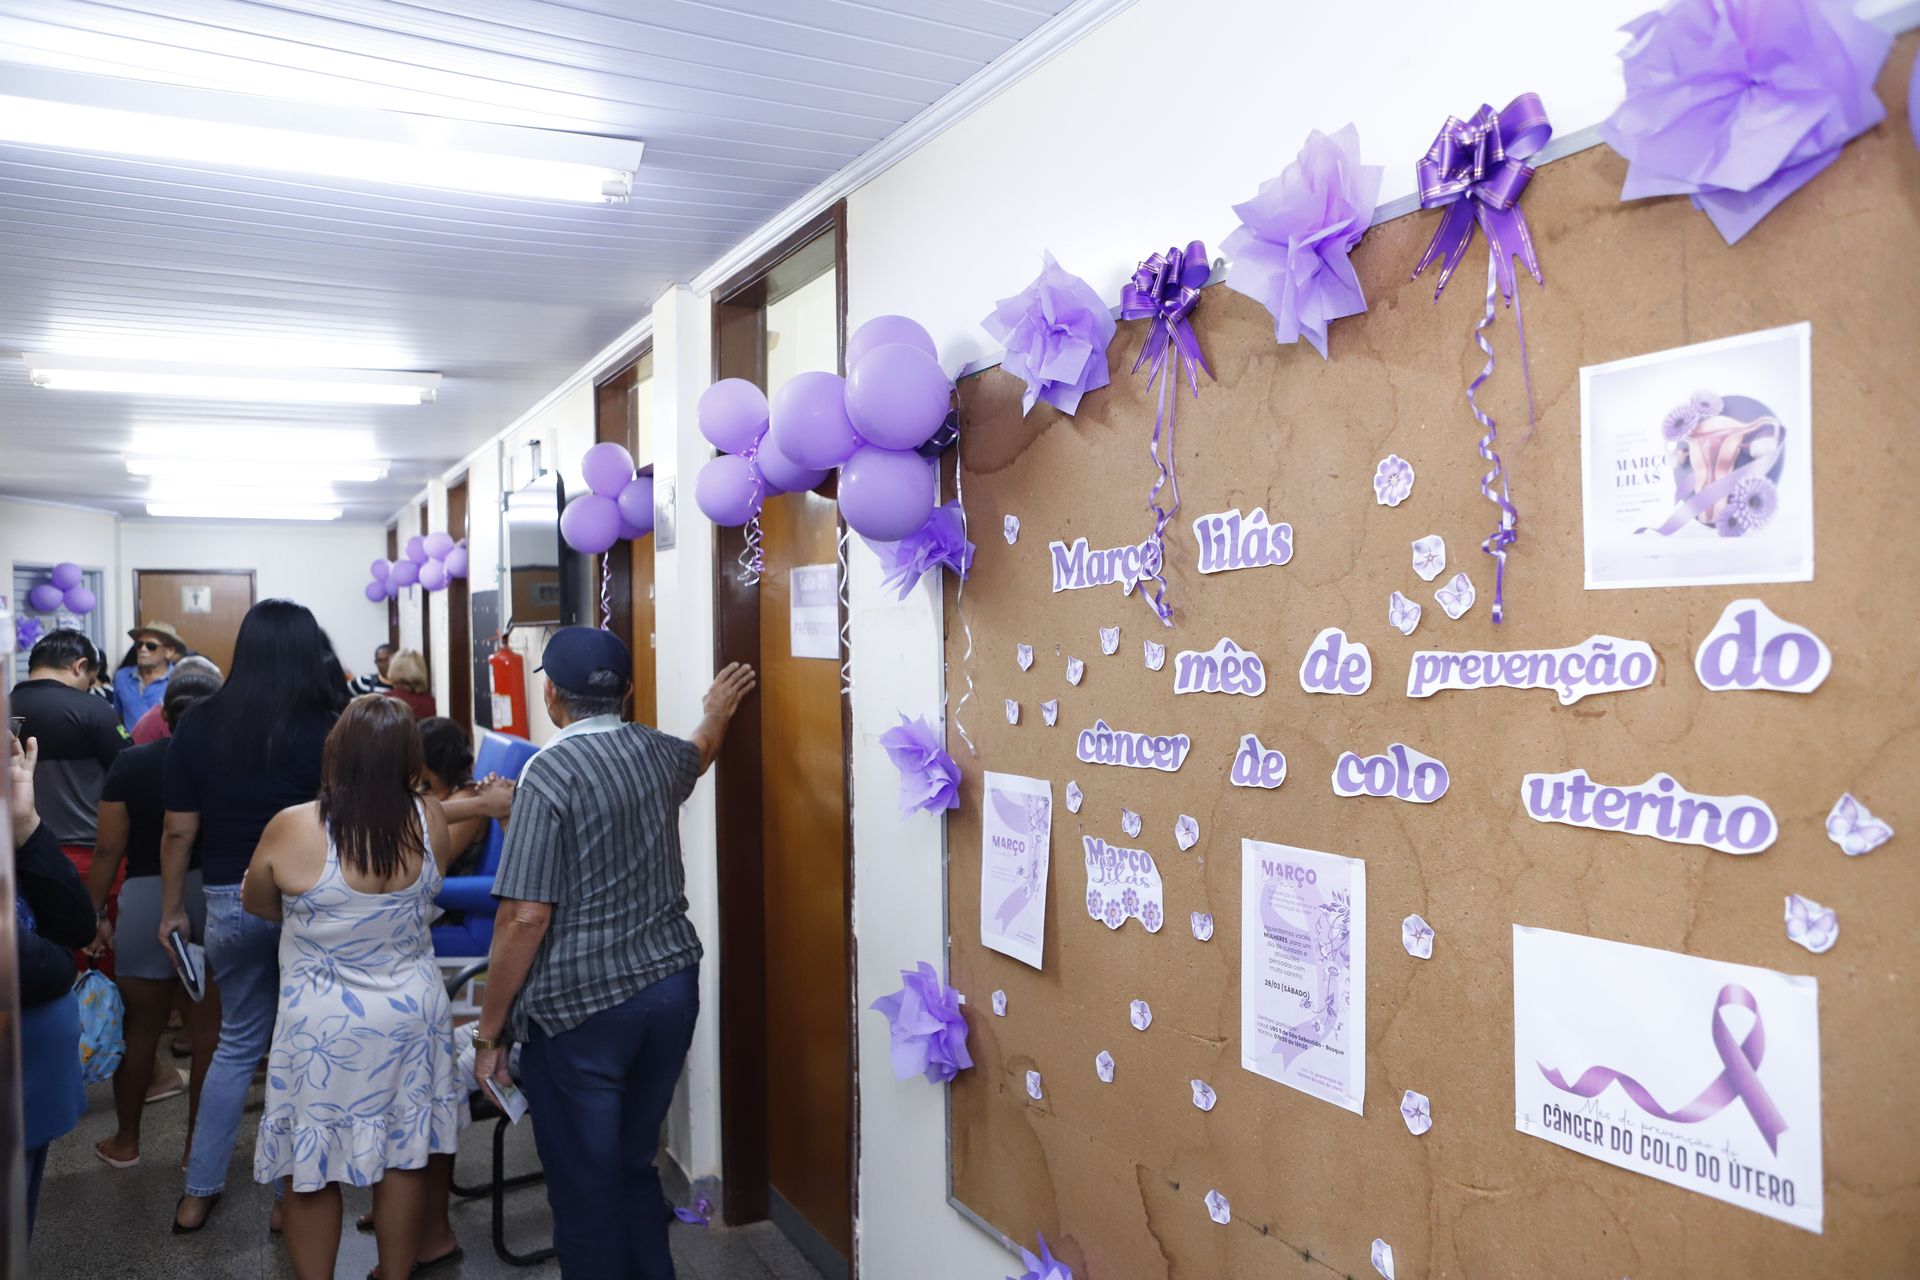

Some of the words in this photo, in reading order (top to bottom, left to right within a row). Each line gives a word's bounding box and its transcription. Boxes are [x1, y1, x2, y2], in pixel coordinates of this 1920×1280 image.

[1616, 469, 1661, 487] LILÁS
[1052, 541, 1161, 594] Março
[1197, 512, 1290, 570] lilás
[1178, 642, 1261, 693] mês
[1304, 633, 1365, 692] de
[1412, 642, 1652, 697] prevenção
[1701, 609, 1820, 686] do
[1078, 721, 1189, 769] câncer
[1232, 737, 1284, 787] de
[1337, 745, 1448, 801] colo
[1530, 775, 1771, 849] uterino
[992, 835, 1025, 856] MARÇO
[1261, 859, 1318, 888] MARÇO
[1281, 983, 1311, 1000] (SÁBADO)
[1325, 1044, 1345, 1056] Bosque
[1610, 1124, 1634, 1156] DO
[1640, 1133, 1688, 1173] COLO
[1695, 1150, 1721, 1183] DO
[1728, 1156, 1797, 1209] ÚTERO
